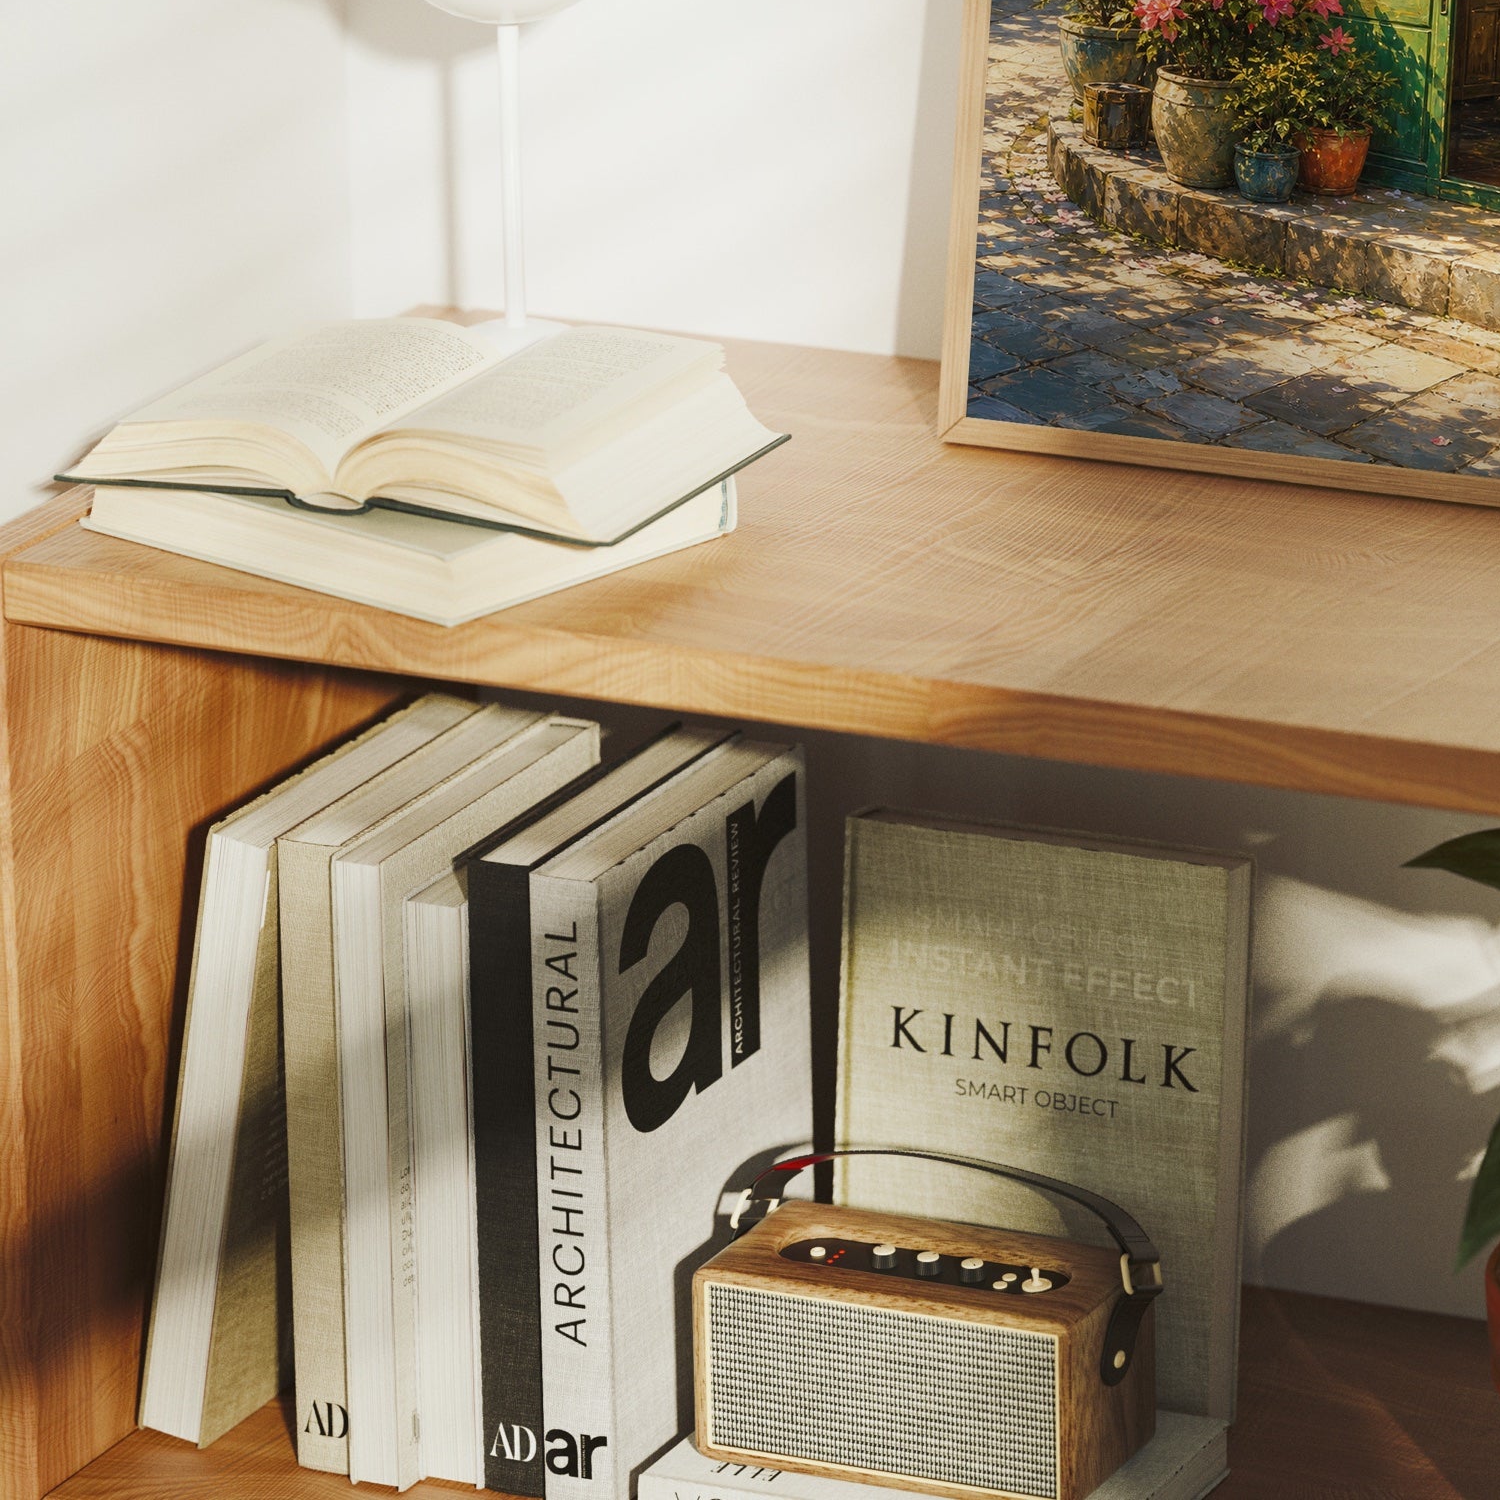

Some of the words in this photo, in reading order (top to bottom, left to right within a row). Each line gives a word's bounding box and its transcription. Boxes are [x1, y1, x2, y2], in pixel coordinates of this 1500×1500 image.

[730, 821, 741, 892] REVIEW
[620, 771, 797, 1133] ar
[733, 897, 744, 1055] ARCHITECTURAL
[1063, 961, 1198, 1008] EFFECT
[890, 1005, 1200, 1093] KINFOLK
[955, 1078, 1029, 1107] SMART
[1034, 1090, 1119, 1119] OBJECT
[544, 920, 588, 1348] ARCHITECTURAL
[304, 1399, 349, 1439] AD
[489, 1421, 538, 1463] AD
[545, 1429, 608, 1480] ar
